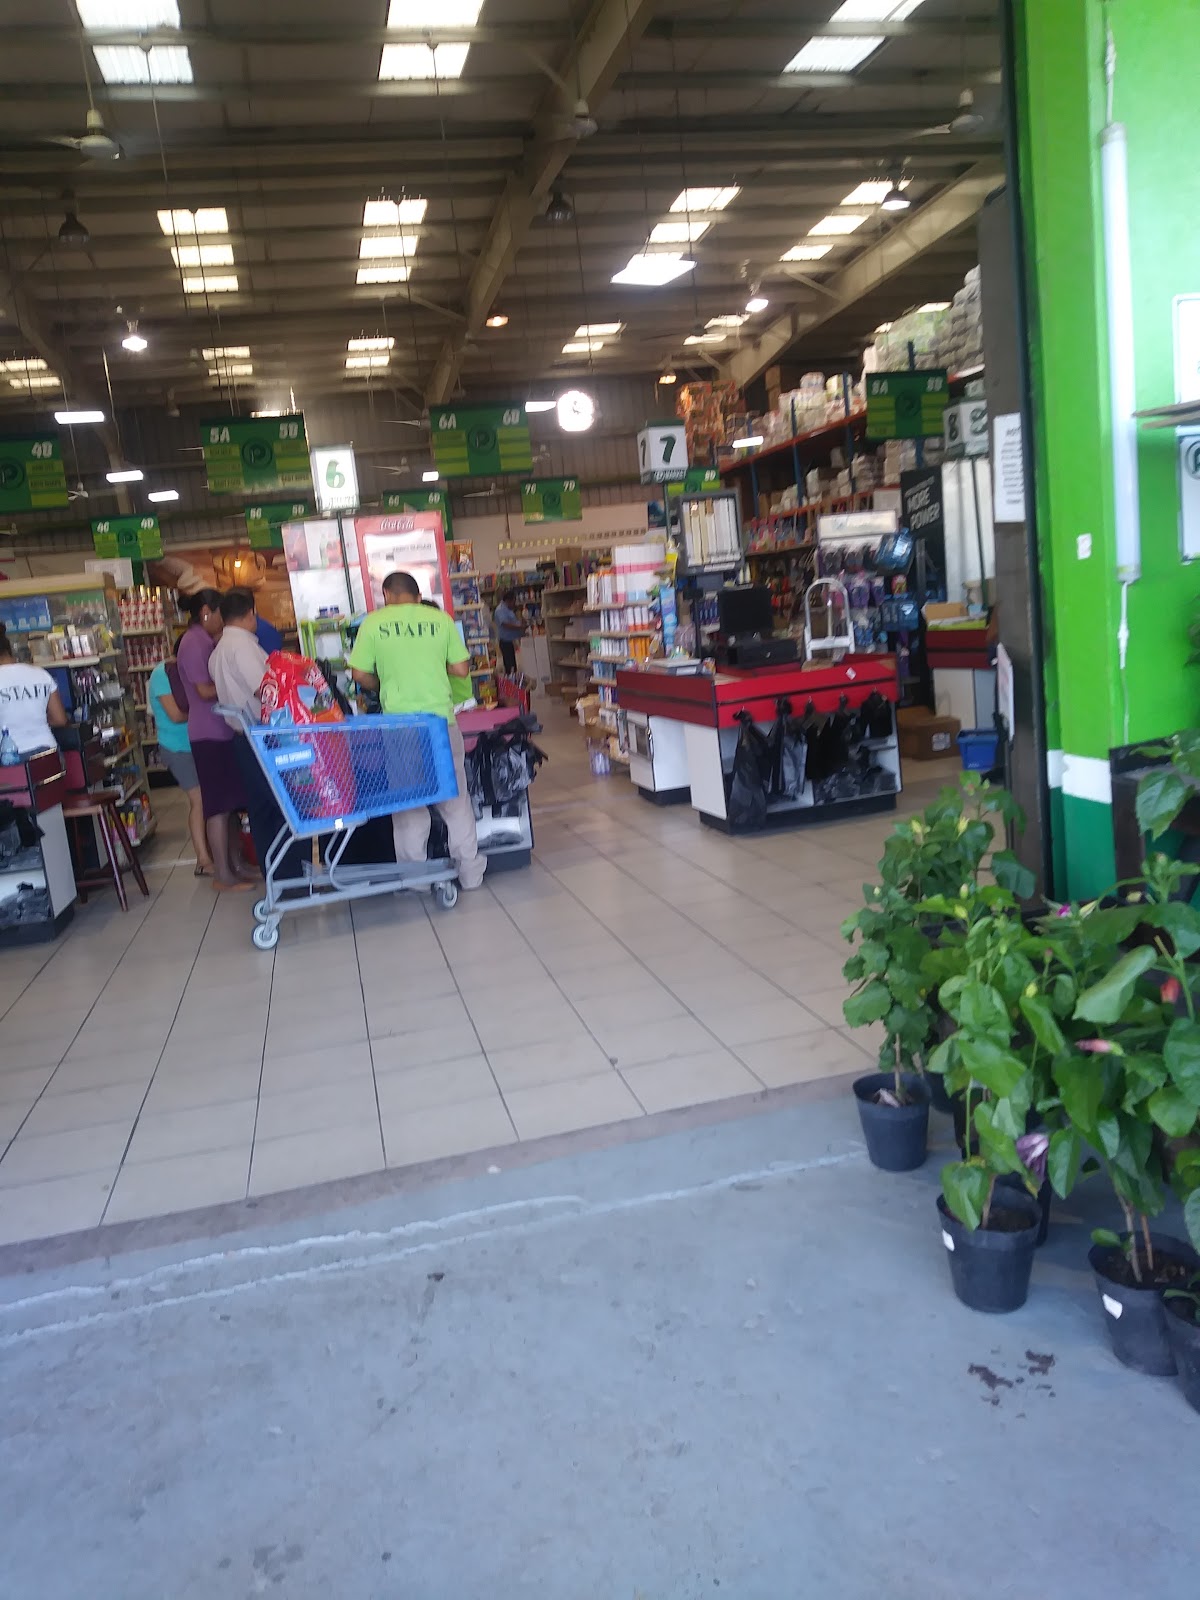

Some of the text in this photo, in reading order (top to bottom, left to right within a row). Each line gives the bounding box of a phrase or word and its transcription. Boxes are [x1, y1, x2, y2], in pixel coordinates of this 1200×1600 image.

[439, 413, 456, 429] 6A
[209, 426, 230, 443] 5A
[660, 432, 677, 465] 7
[326, 458, 346, 488] 6
[910, 502, 941, 531] POWER
[378, 621, 441, 640] STAFF
[0, 683, 51, 704] STAFF
